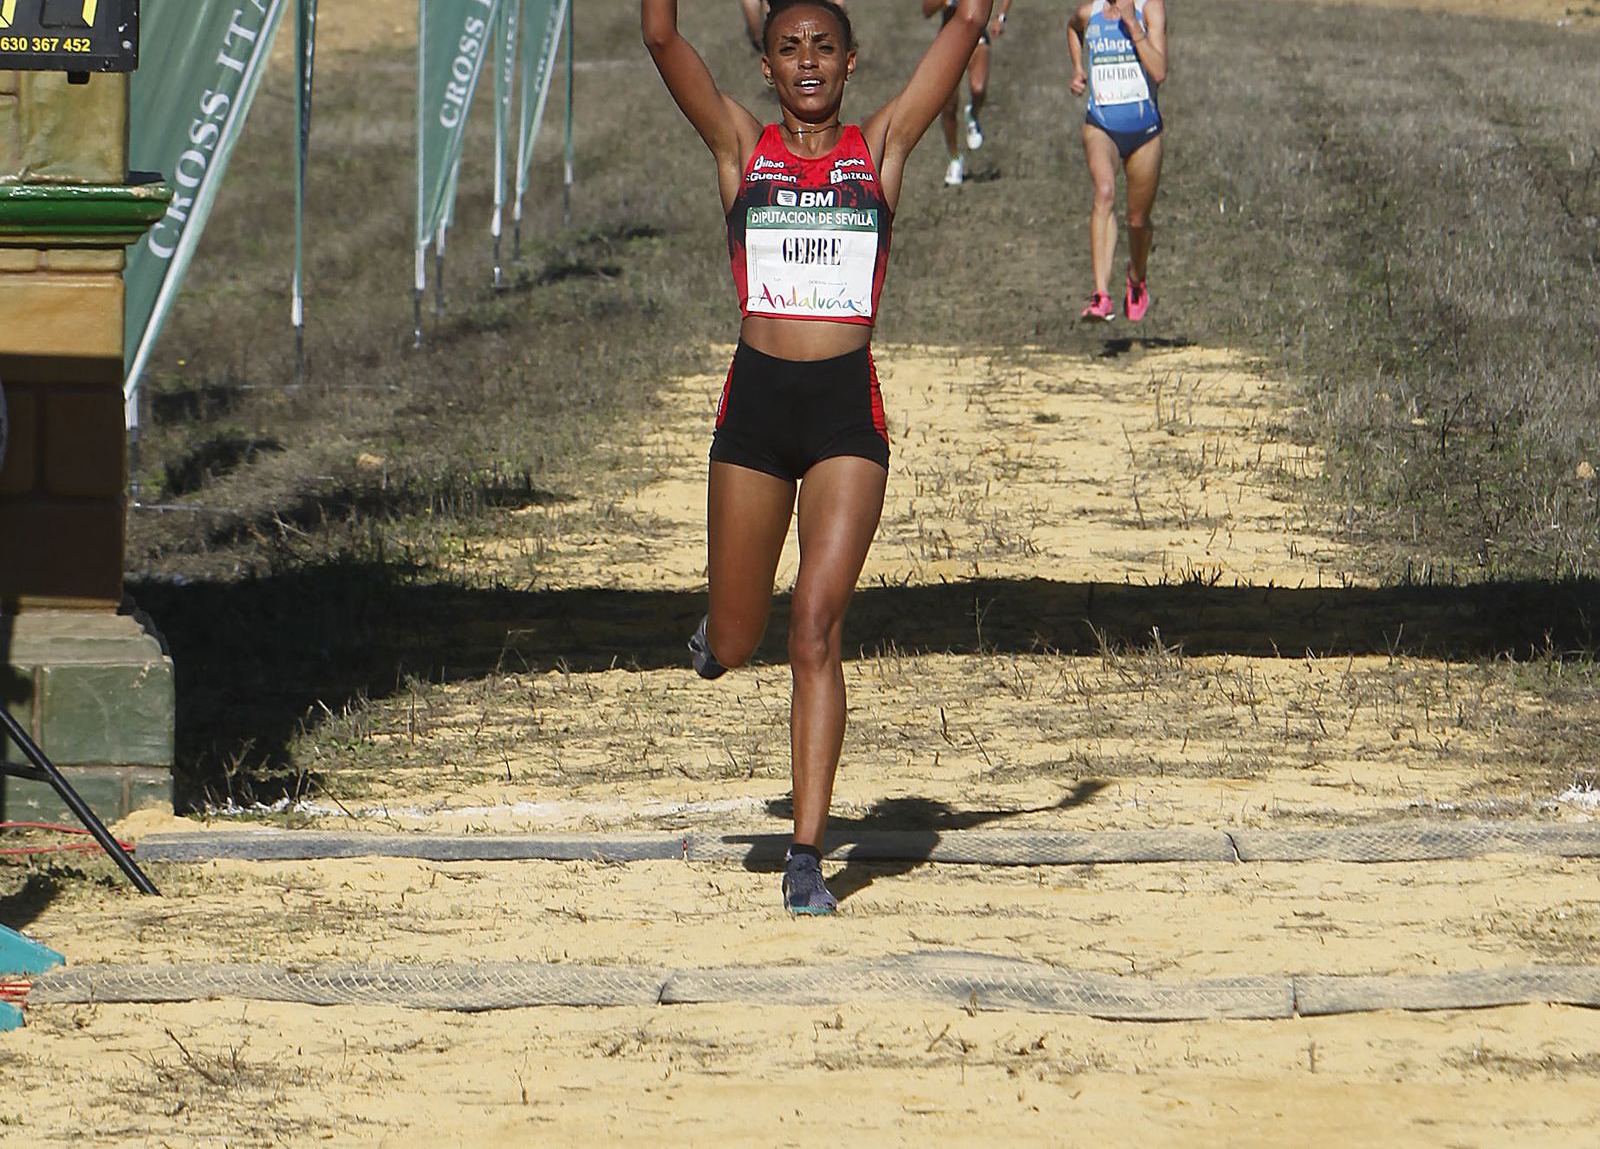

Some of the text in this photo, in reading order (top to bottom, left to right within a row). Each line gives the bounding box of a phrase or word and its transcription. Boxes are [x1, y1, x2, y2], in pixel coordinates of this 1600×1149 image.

[0, 37, 91, 52] 630 367 452
[439, 16, 485, 128] CROSS
[148, 89, 230, 259] CROSS
[800, 191, 834, 207] BM
[751, 211, 874, 226] DIPUTACION DE SEVILLA
[782, 236, 842, 266] GEBRE
[752, 282, 863, 314] Andalucía
